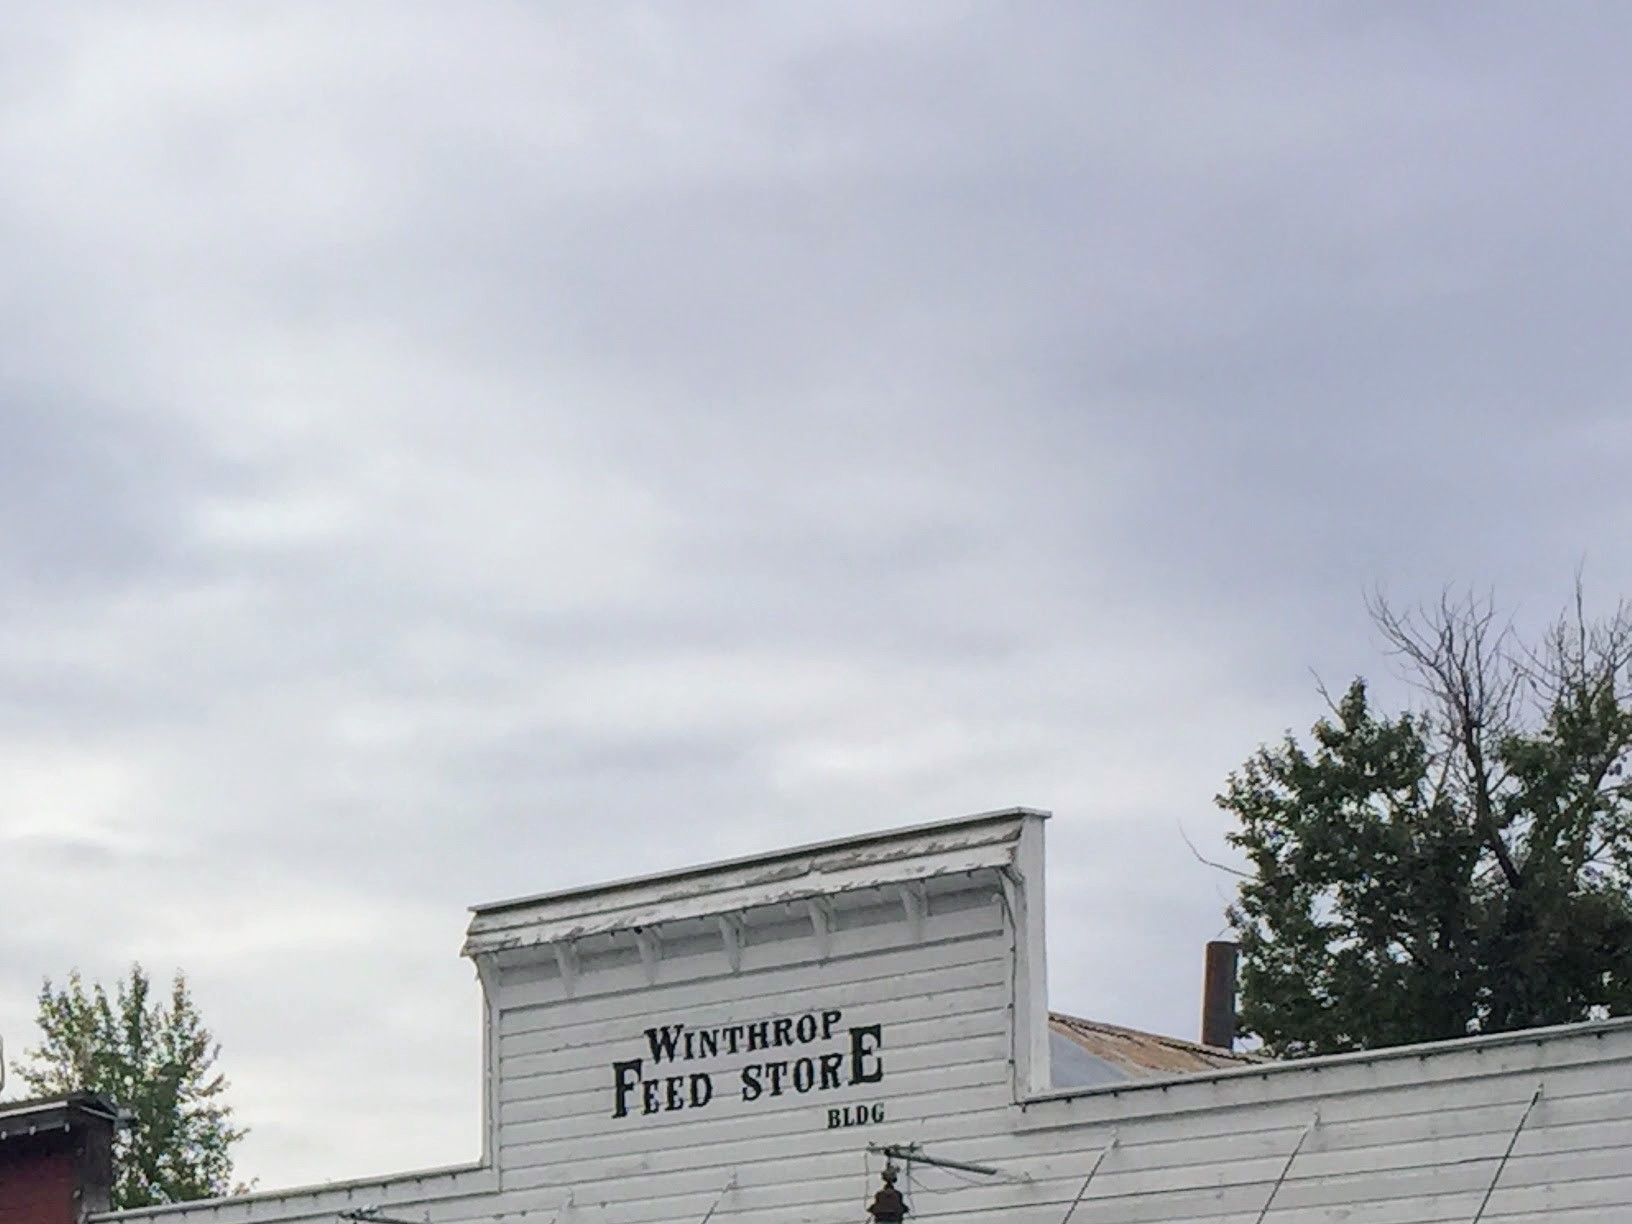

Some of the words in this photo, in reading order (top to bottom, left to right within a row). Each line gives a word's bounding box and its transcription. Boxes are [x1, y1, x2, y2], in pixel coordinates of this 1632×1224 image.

[644, 1011, 841, 1064] WINTHROP
[612, 1058, 713, 1119] FEED
[741, 1024, 883, 1102] STORE
[828, 1103, 884, 1129] BLDG
